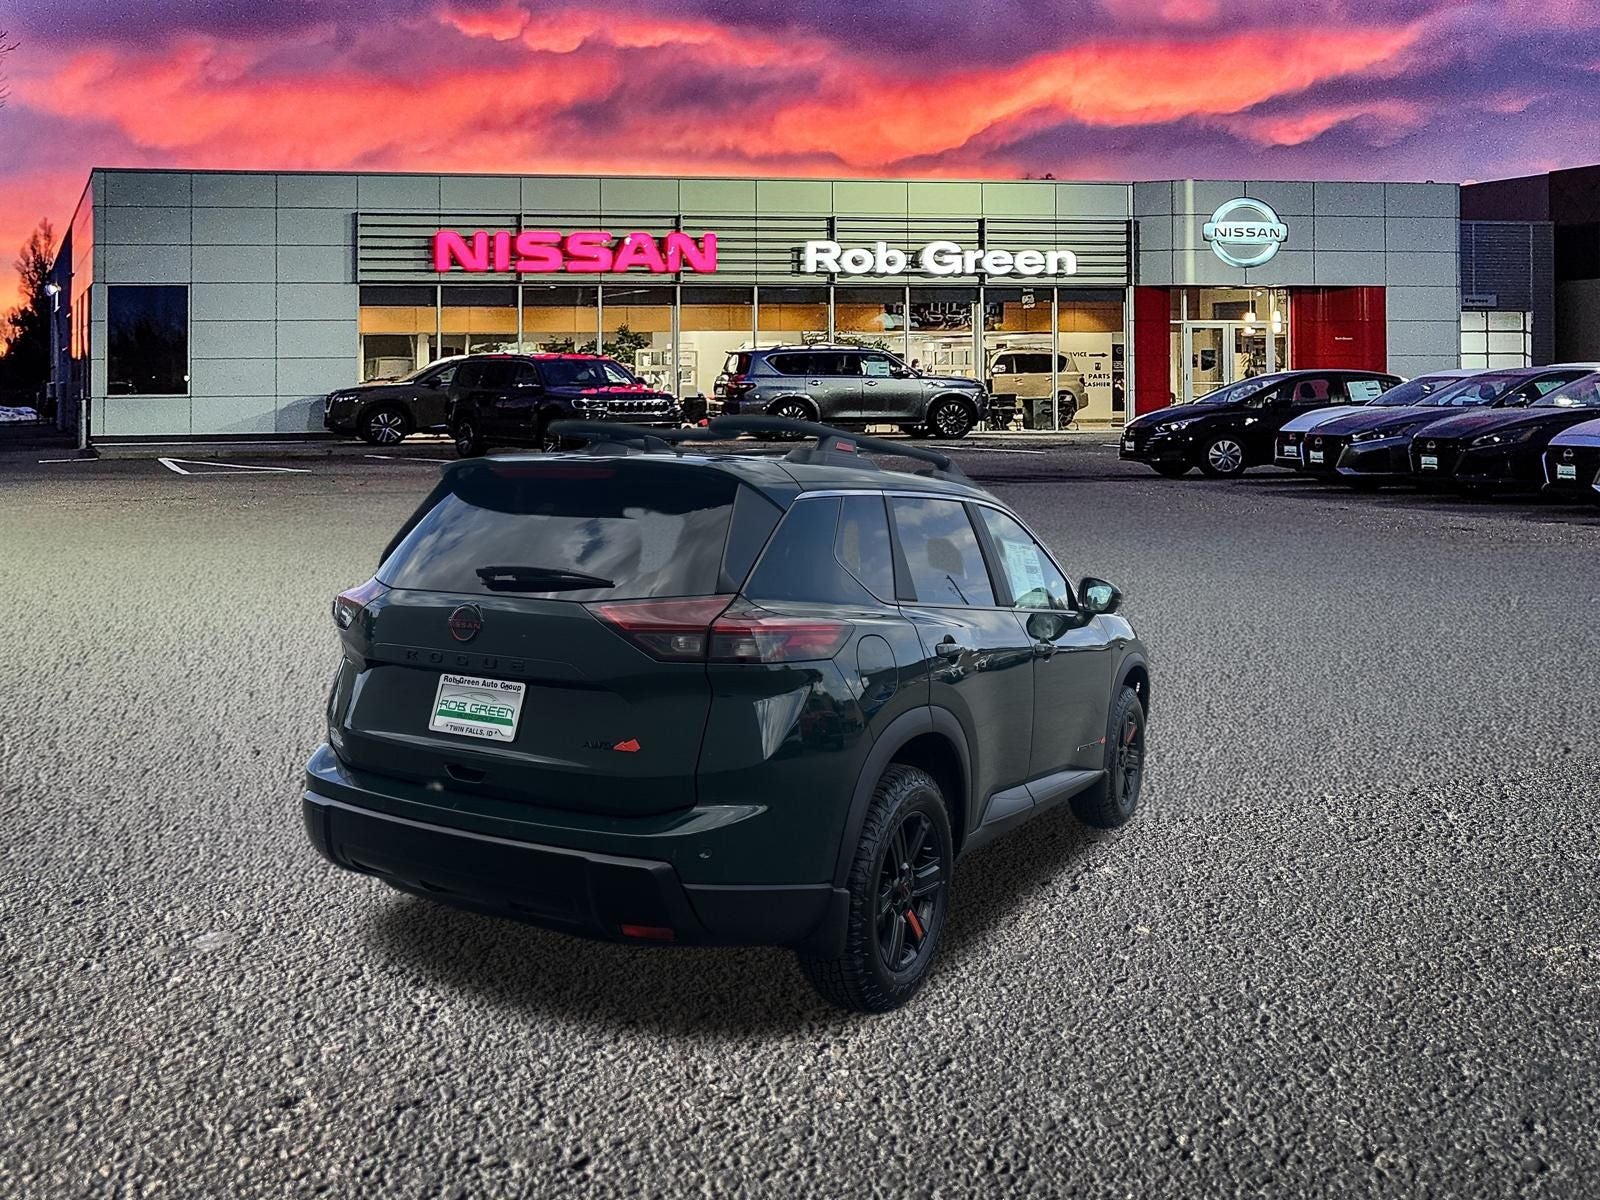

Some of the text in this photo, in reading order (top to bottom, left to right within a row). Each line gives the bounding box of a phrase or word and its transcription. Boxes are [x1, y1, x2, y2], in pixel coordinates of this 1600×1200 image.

[1214, 227, 1280, 238] NISSAN
[433, 230, 718, 273] NISSAN
[803, 240, 1078, 276] Rob Green
[443, 675, 458, 685] Rob
[459, 677, 480, 688] Green
[481, 680, 499, 689] Auto
[440, 699, 468, 712] ROB
[469, 703, 515, 719] GREEN
